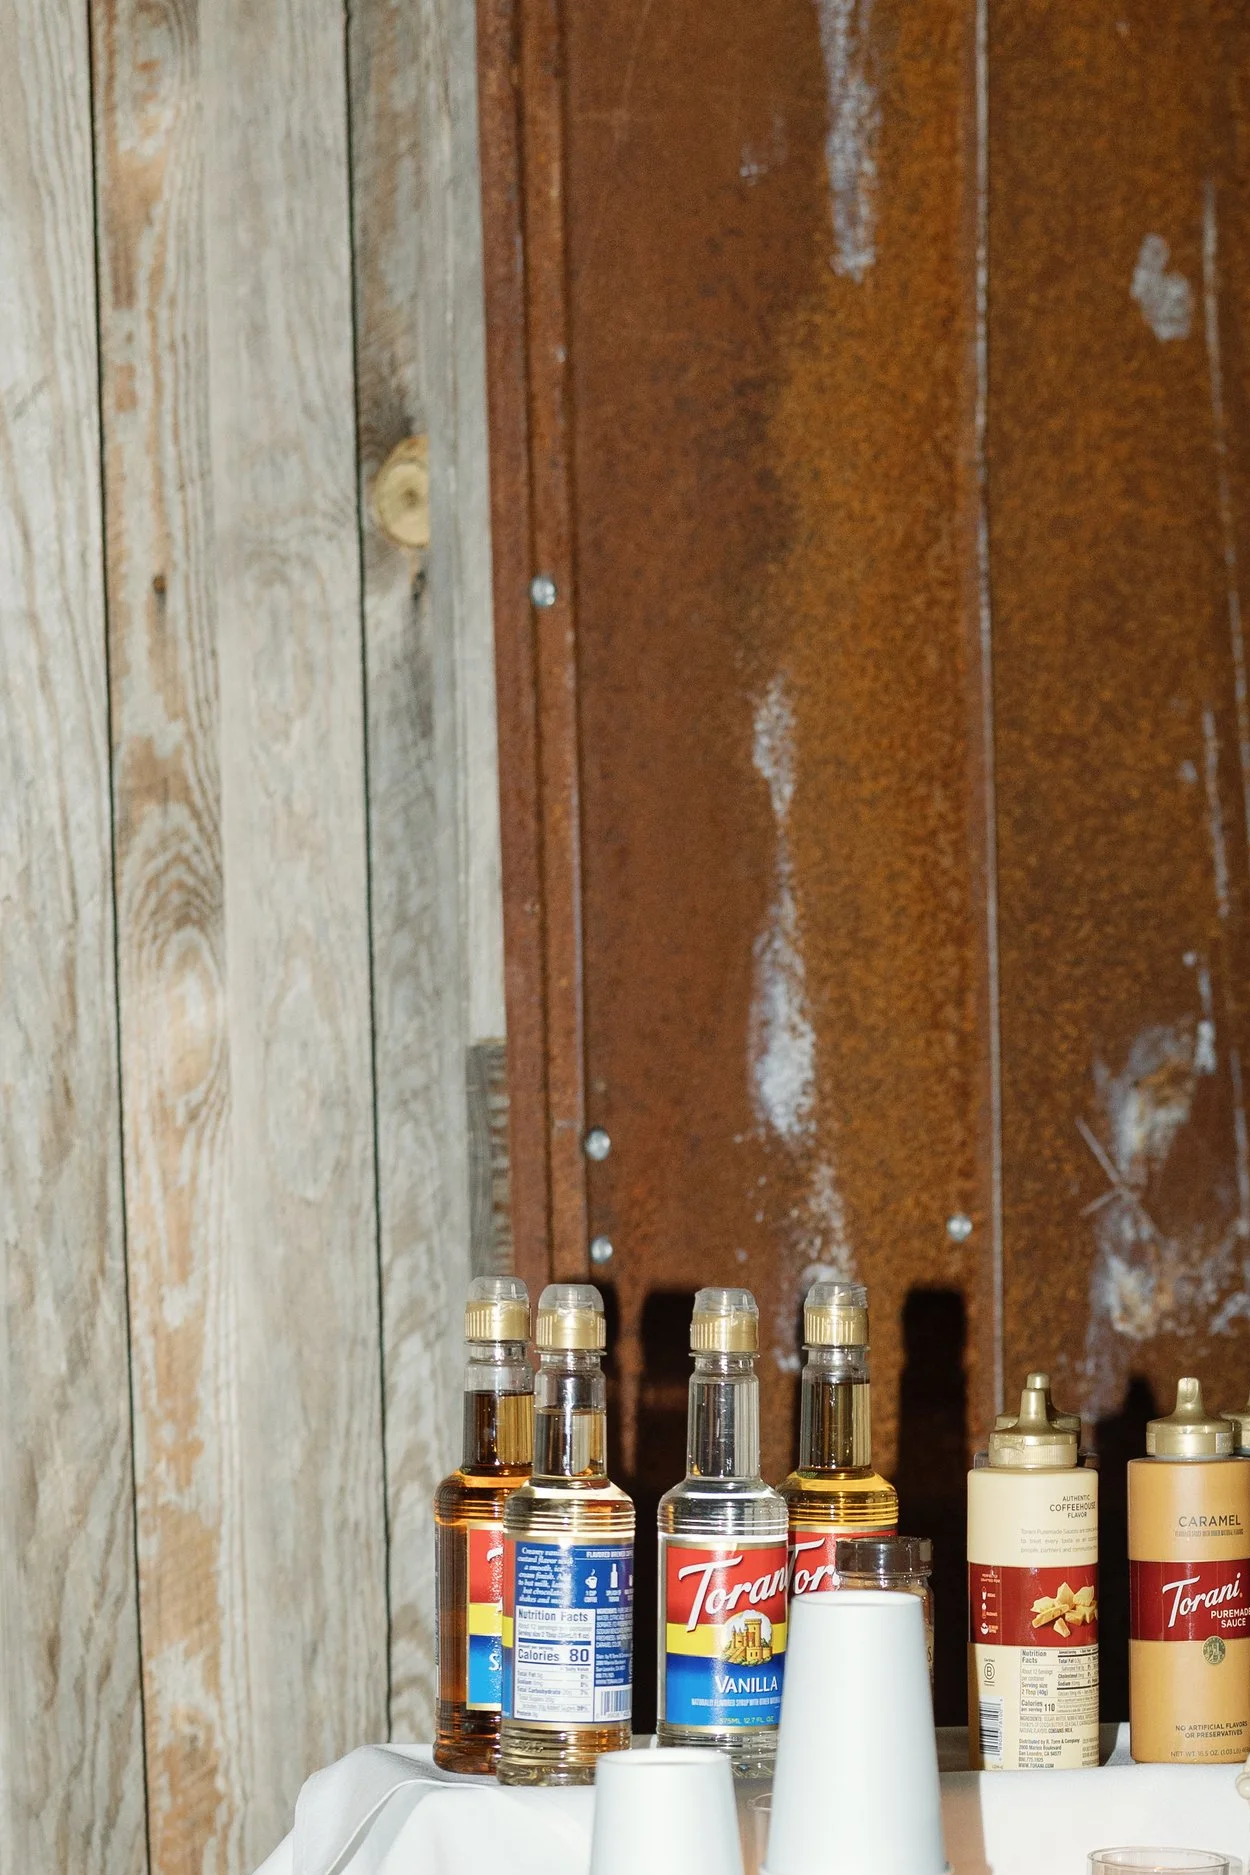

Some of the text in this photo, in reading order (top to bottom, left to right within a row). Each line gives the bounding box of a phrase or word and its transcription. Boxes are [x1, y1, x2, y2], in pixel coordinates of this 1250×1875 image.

[1062, 1494, 1090, 1502] AUTHENTIC
[1049, 1501, 1096, 1512] COFFEEHOUSE
[1178, 1514, 1242, 1528] CARAMEL
[678, 1554, 787, 1633] Toran
[1162, 1572, 1242, 1628] Torani
[519, 1609, 589, 1622] Nutrition Facts
[1221, 1617, 1247, 1628] SAUCE
[518, 1649, 590, 1662] Calories 80
[715, 1676, 779, 1694] VANILLA
[1044, 1703, 1056, 1712] 110
[1189, 1723, 1224, 1731] ARTIFICIAL
[1226, 1721, 1248, 1729] FLAVORS
[1196, 1730, 1243, 1738] PRESERVATIVES
